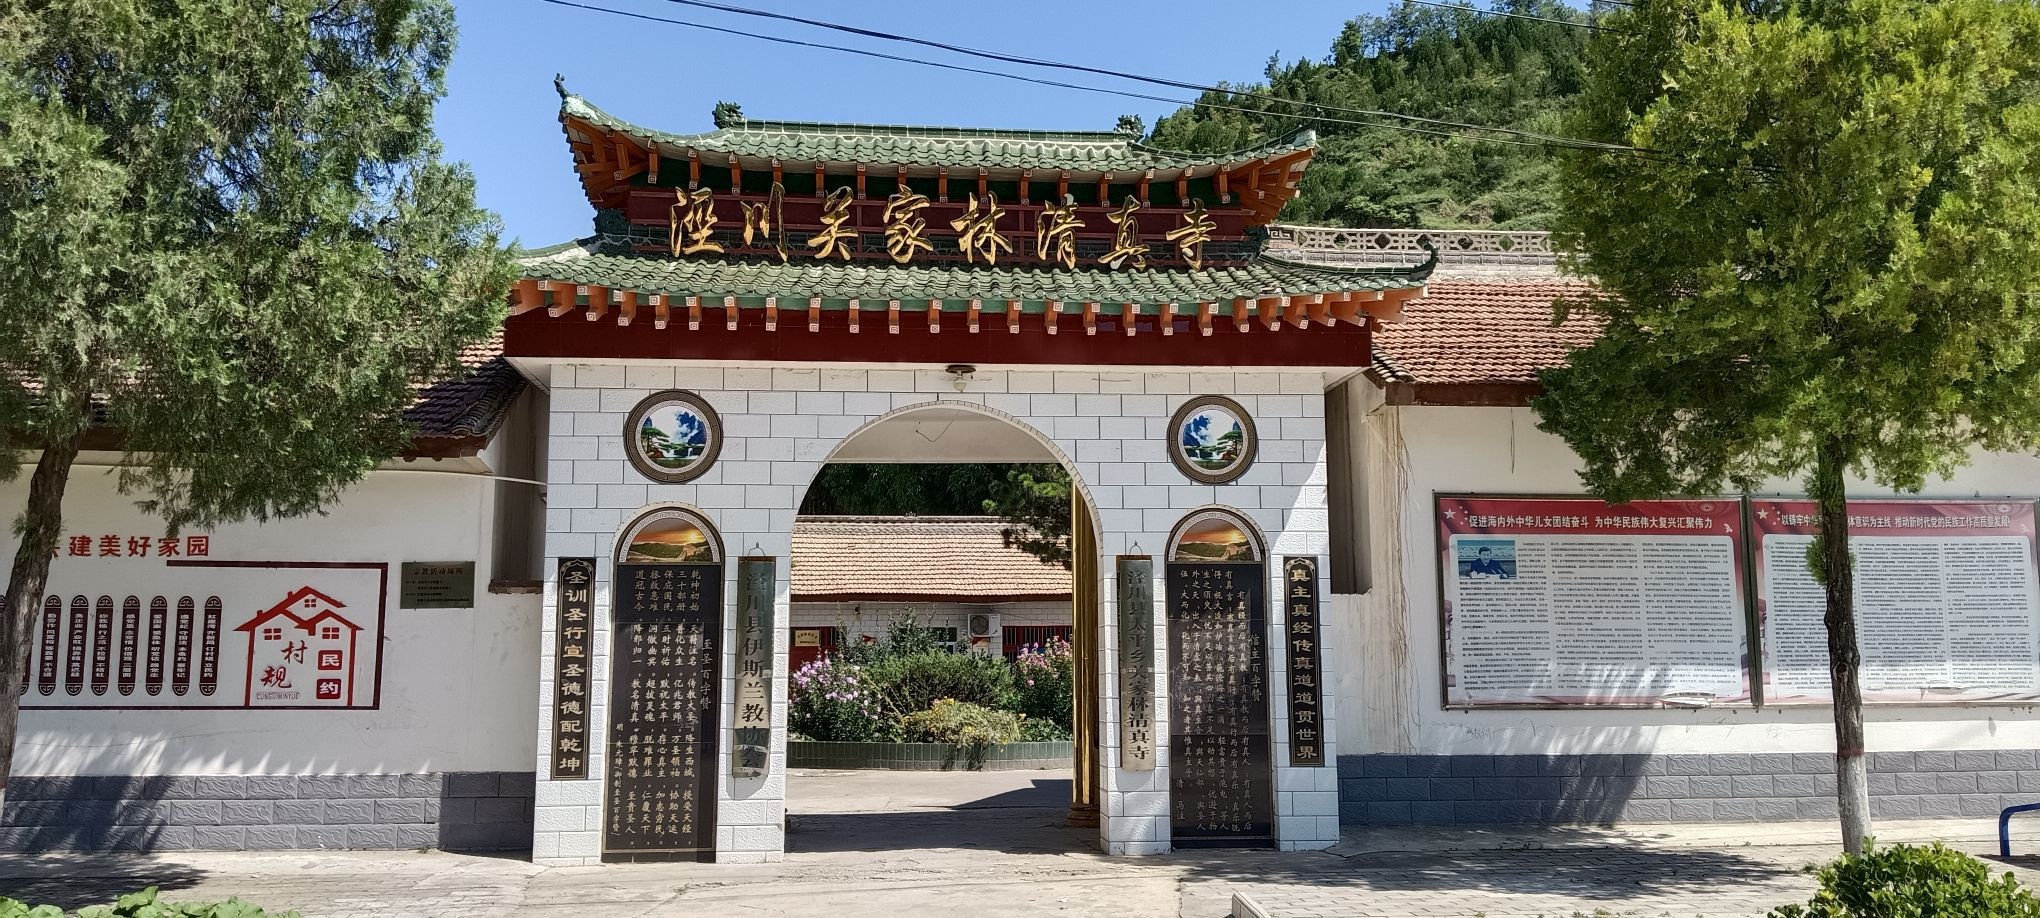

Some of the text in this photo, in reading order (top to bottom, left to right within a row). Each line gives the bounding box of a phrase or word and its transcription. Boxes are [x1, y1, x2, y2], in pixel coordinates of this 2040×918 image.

[51, 535, 209, 557] 建美好家园
[1469, 515, 1713, 529] 促进海内外中华儿女团结奋斗 为中华民族伟大复兴汇聚伟力
[558, 571, 588, 772] 圣训圣行宣圣德德配乾坤
[1290, 568, 1318, 760] 真主真经传真道道贯世界
